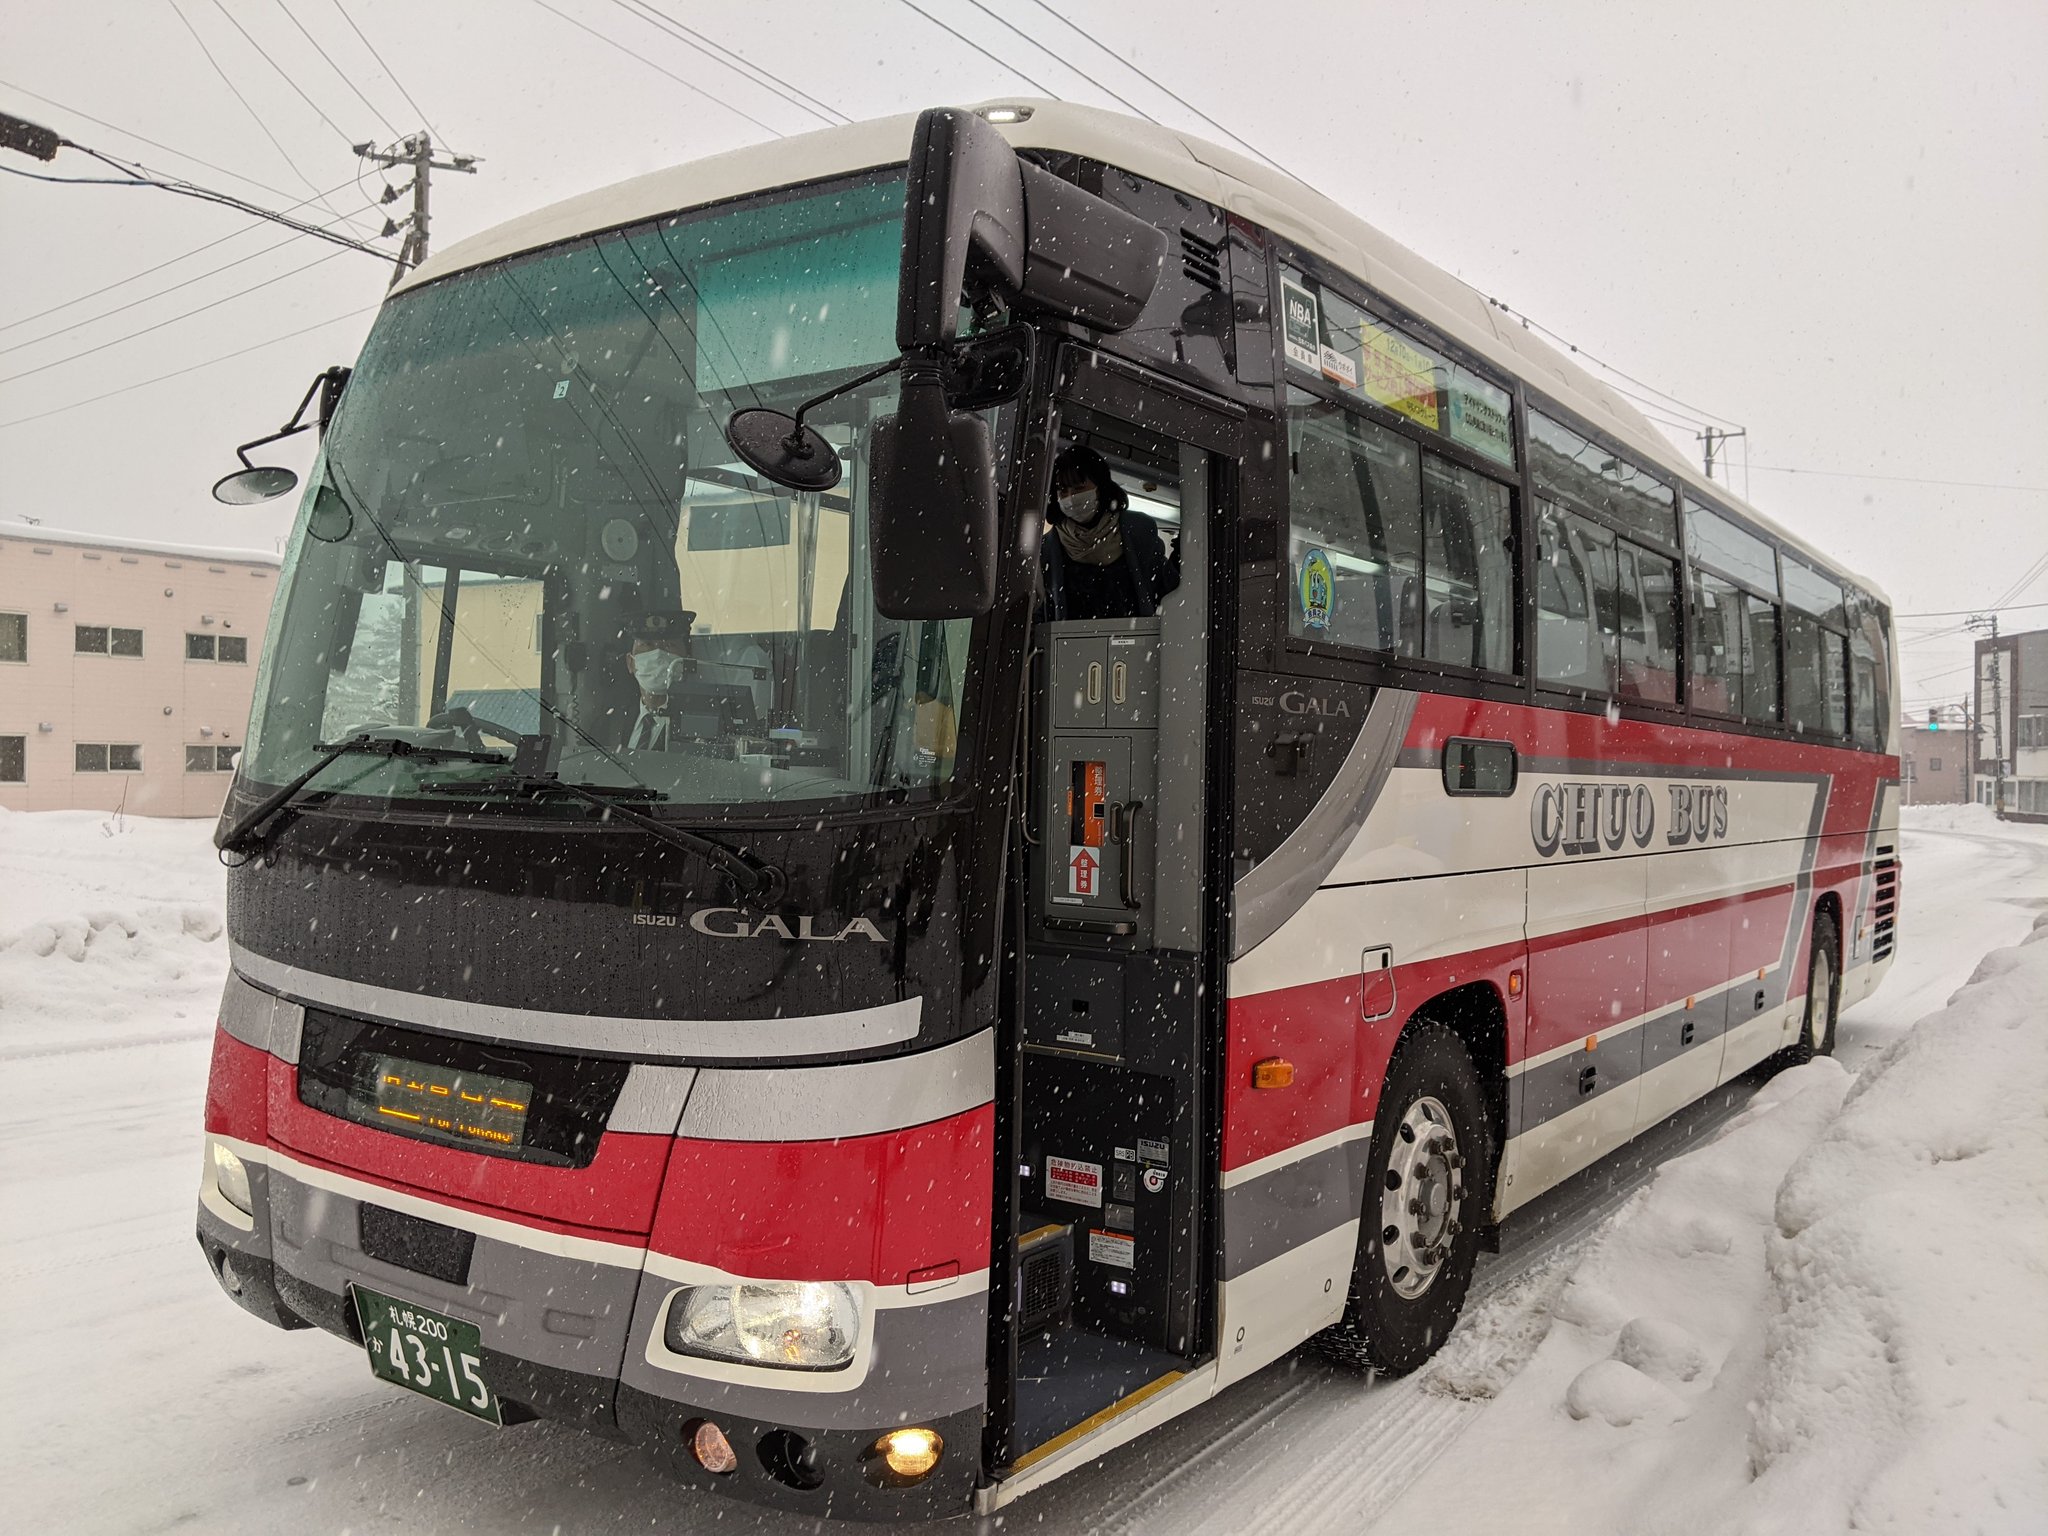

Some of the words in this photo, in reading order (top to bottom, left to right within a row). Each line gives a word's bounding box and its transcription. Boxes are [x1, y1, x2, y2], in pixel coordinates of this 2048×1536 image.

[1289, 299, 1312, 325] NBA
[1251, 696, 1275, 707] ISUZU
[1279, 691, 1350, 718] GALA
[1530, 782, 1655, 858] CHUO
[1666, 784, 1728, 847] BUS
[632, 913, 677, 927] ISUZU
[689, 907, 889, 942] GALA
[1140, 1140, 1165, 1150] ISUZU
[372, 1336, 383, 1354] か
[389, 1327, 489, 1409] 43-15
